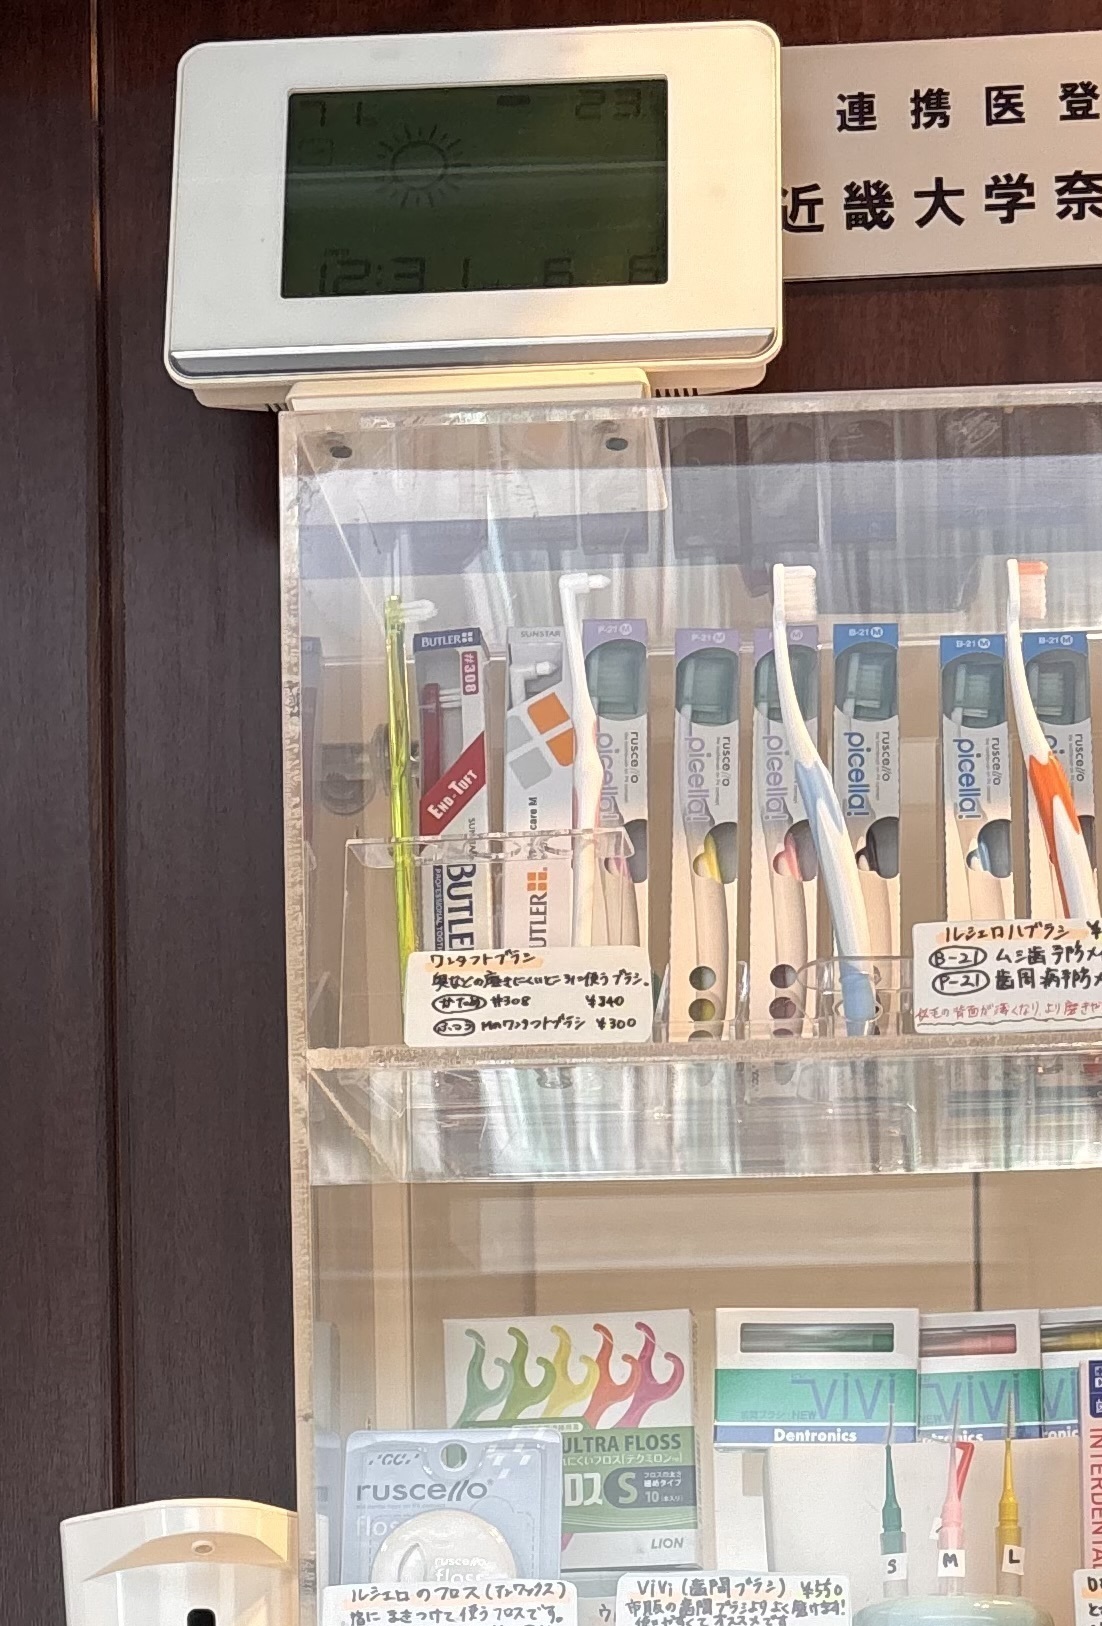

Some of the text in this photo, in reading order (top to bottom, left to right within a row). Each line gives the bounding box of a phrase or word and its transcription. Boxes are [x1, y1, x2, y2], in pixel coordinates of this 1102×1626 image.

[520, 629, 561, 639] SUNSTAR
[691, 632, 712, 642] P-21
[849, 627, 871, 638] B-21
[1039, 635, 1060, 645] B-21
[421, 634, 461, 648] BUTLER
[956, 639, 978, 649] B-21
[462, 651, 477, 694] #308
[685, 734, 713, 823] picella!
[763, 733, 790, 822] picella!
[843, 731, 871, 818] picella!
[953, 737, 982, 820] picella!
[446, 864, 476, 951] BUTLE
[489, 993, 532, 1008] #308
[595, 1017, 637, 1030] ¥300
[625, 1433, 682, 1452] FLOSS
[773, 1427, 858, 1443] Dentronics
[617, 1471, 638, 1505] S
[645, 1490, 660, 1503] 10
[650, 1537, 684, 1550] LION
[943, 1553, 959, 1568] M
[1008, 1549, 1020, 1565] L
[887, 1558, 897, 1575] S
[800, 1578, 843, 1599] ¥550
